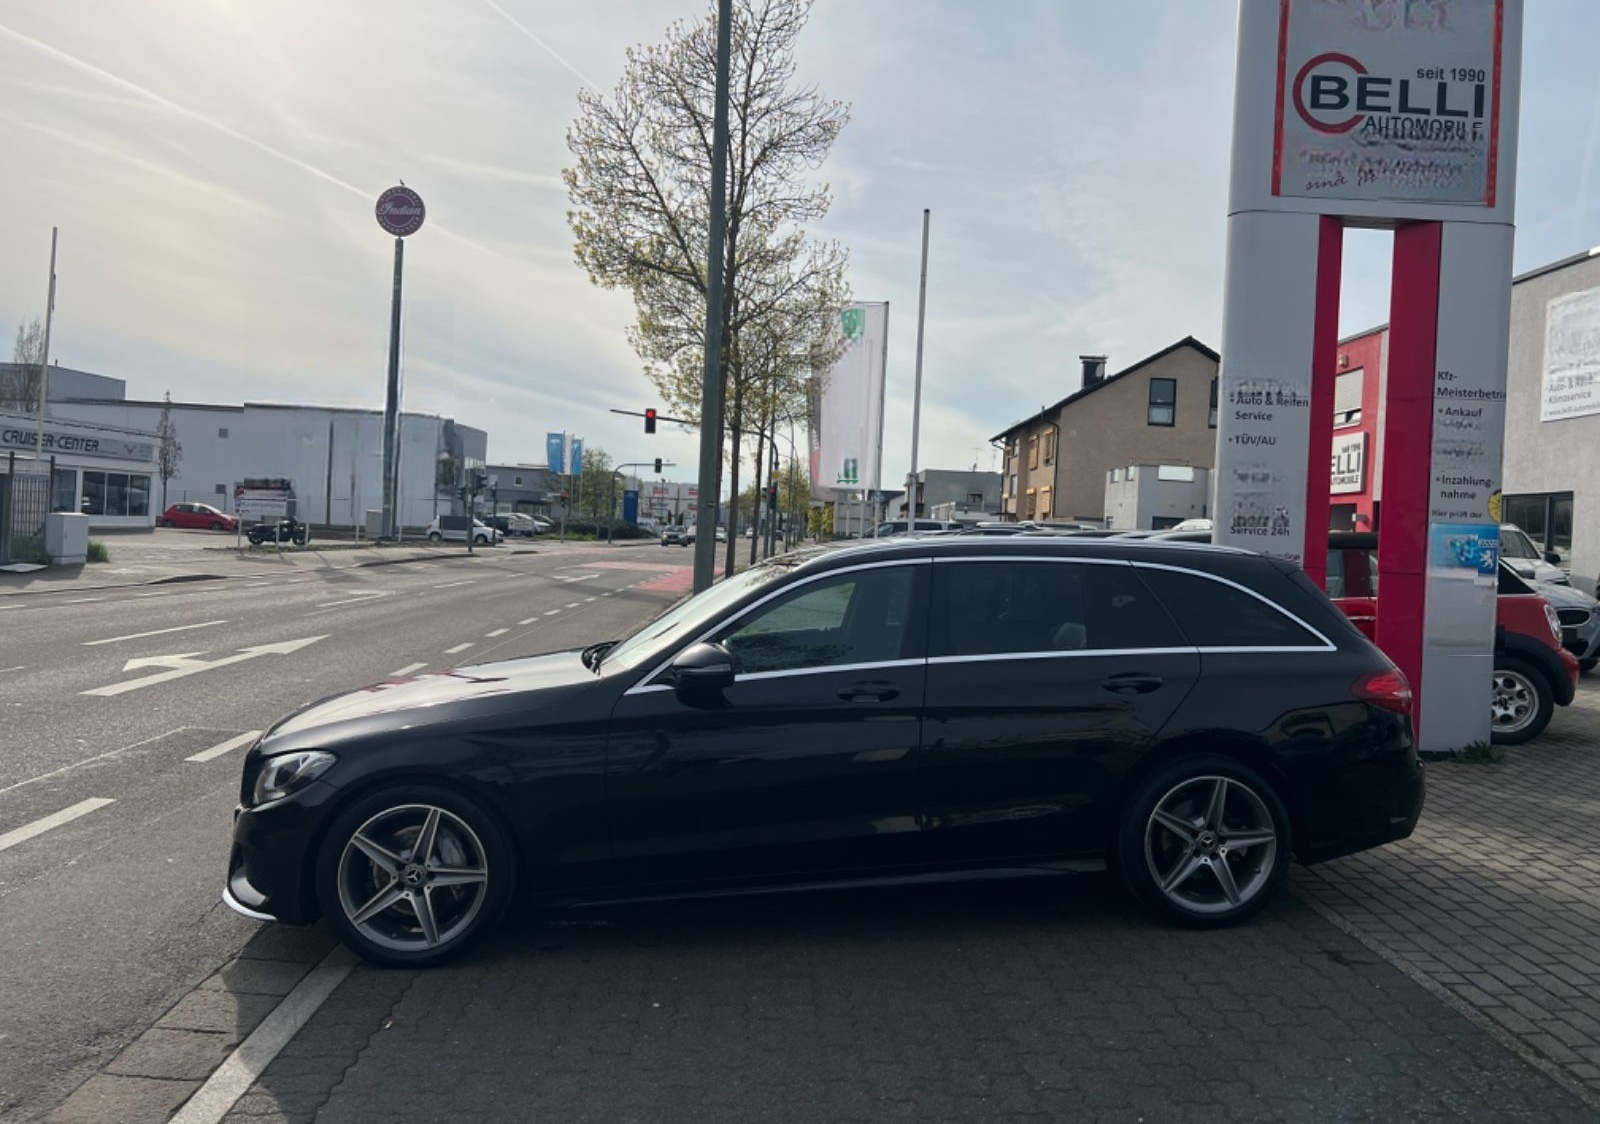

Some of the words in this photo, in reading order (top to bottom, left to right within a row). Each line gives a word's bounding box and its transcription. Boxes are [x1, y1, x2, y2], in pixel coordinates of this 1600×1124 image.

[1417, 67, 1444, 80] seit
[1451, 68, 1485, 83] 1990
[1310, 75, 1485, 118] BELLI
[1437, 371, 1458, 381] Kfz-
[1236, 394, 1263, 405] Auto
[1277, 395, 1309, 408] Reifen
[1235, 410, 1273, 421] Service
[1445, 407, 1483, 417] Ankauf
[1234, 432, 1278, 447] TÜV/AU
[1442, 475, 1495, 488] Inzahlung-
[1440, 489, 1477, 500] nahme
[1230, 526, 1268, 536] Service
[1270, 527, 1290, 537] 24h
